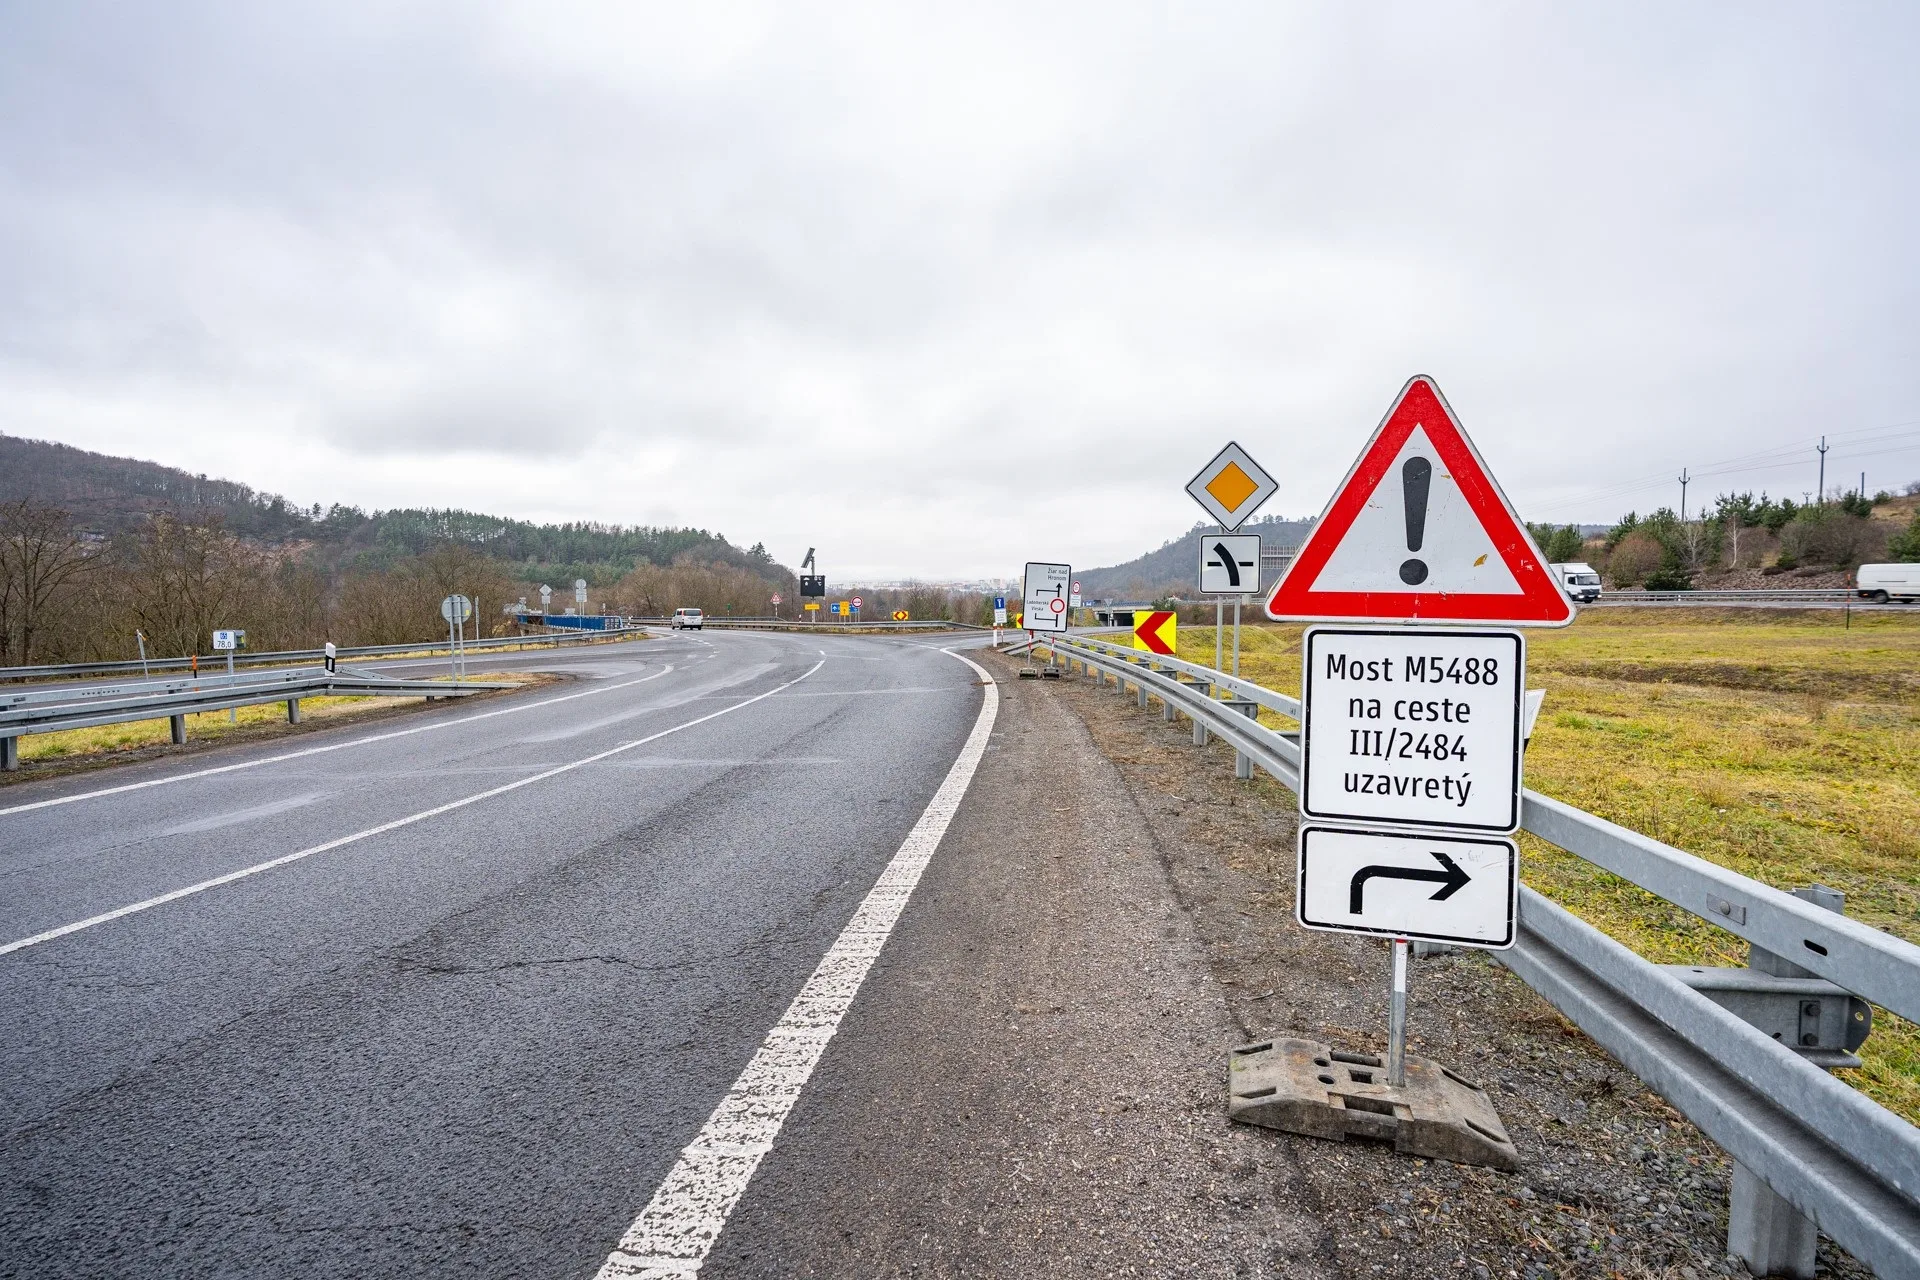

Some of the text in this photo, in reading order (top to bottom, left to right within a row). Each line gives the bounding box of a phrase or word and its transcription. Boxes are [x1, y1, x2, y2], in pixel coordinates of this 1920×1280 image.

[1326, 653, 1499, 686] Most M5488
[1349, 697, 1471, 724] na ceste
[1350, 728, 1468, 762] III/2484
[1344, 772, 1472, 808] uzavretý
